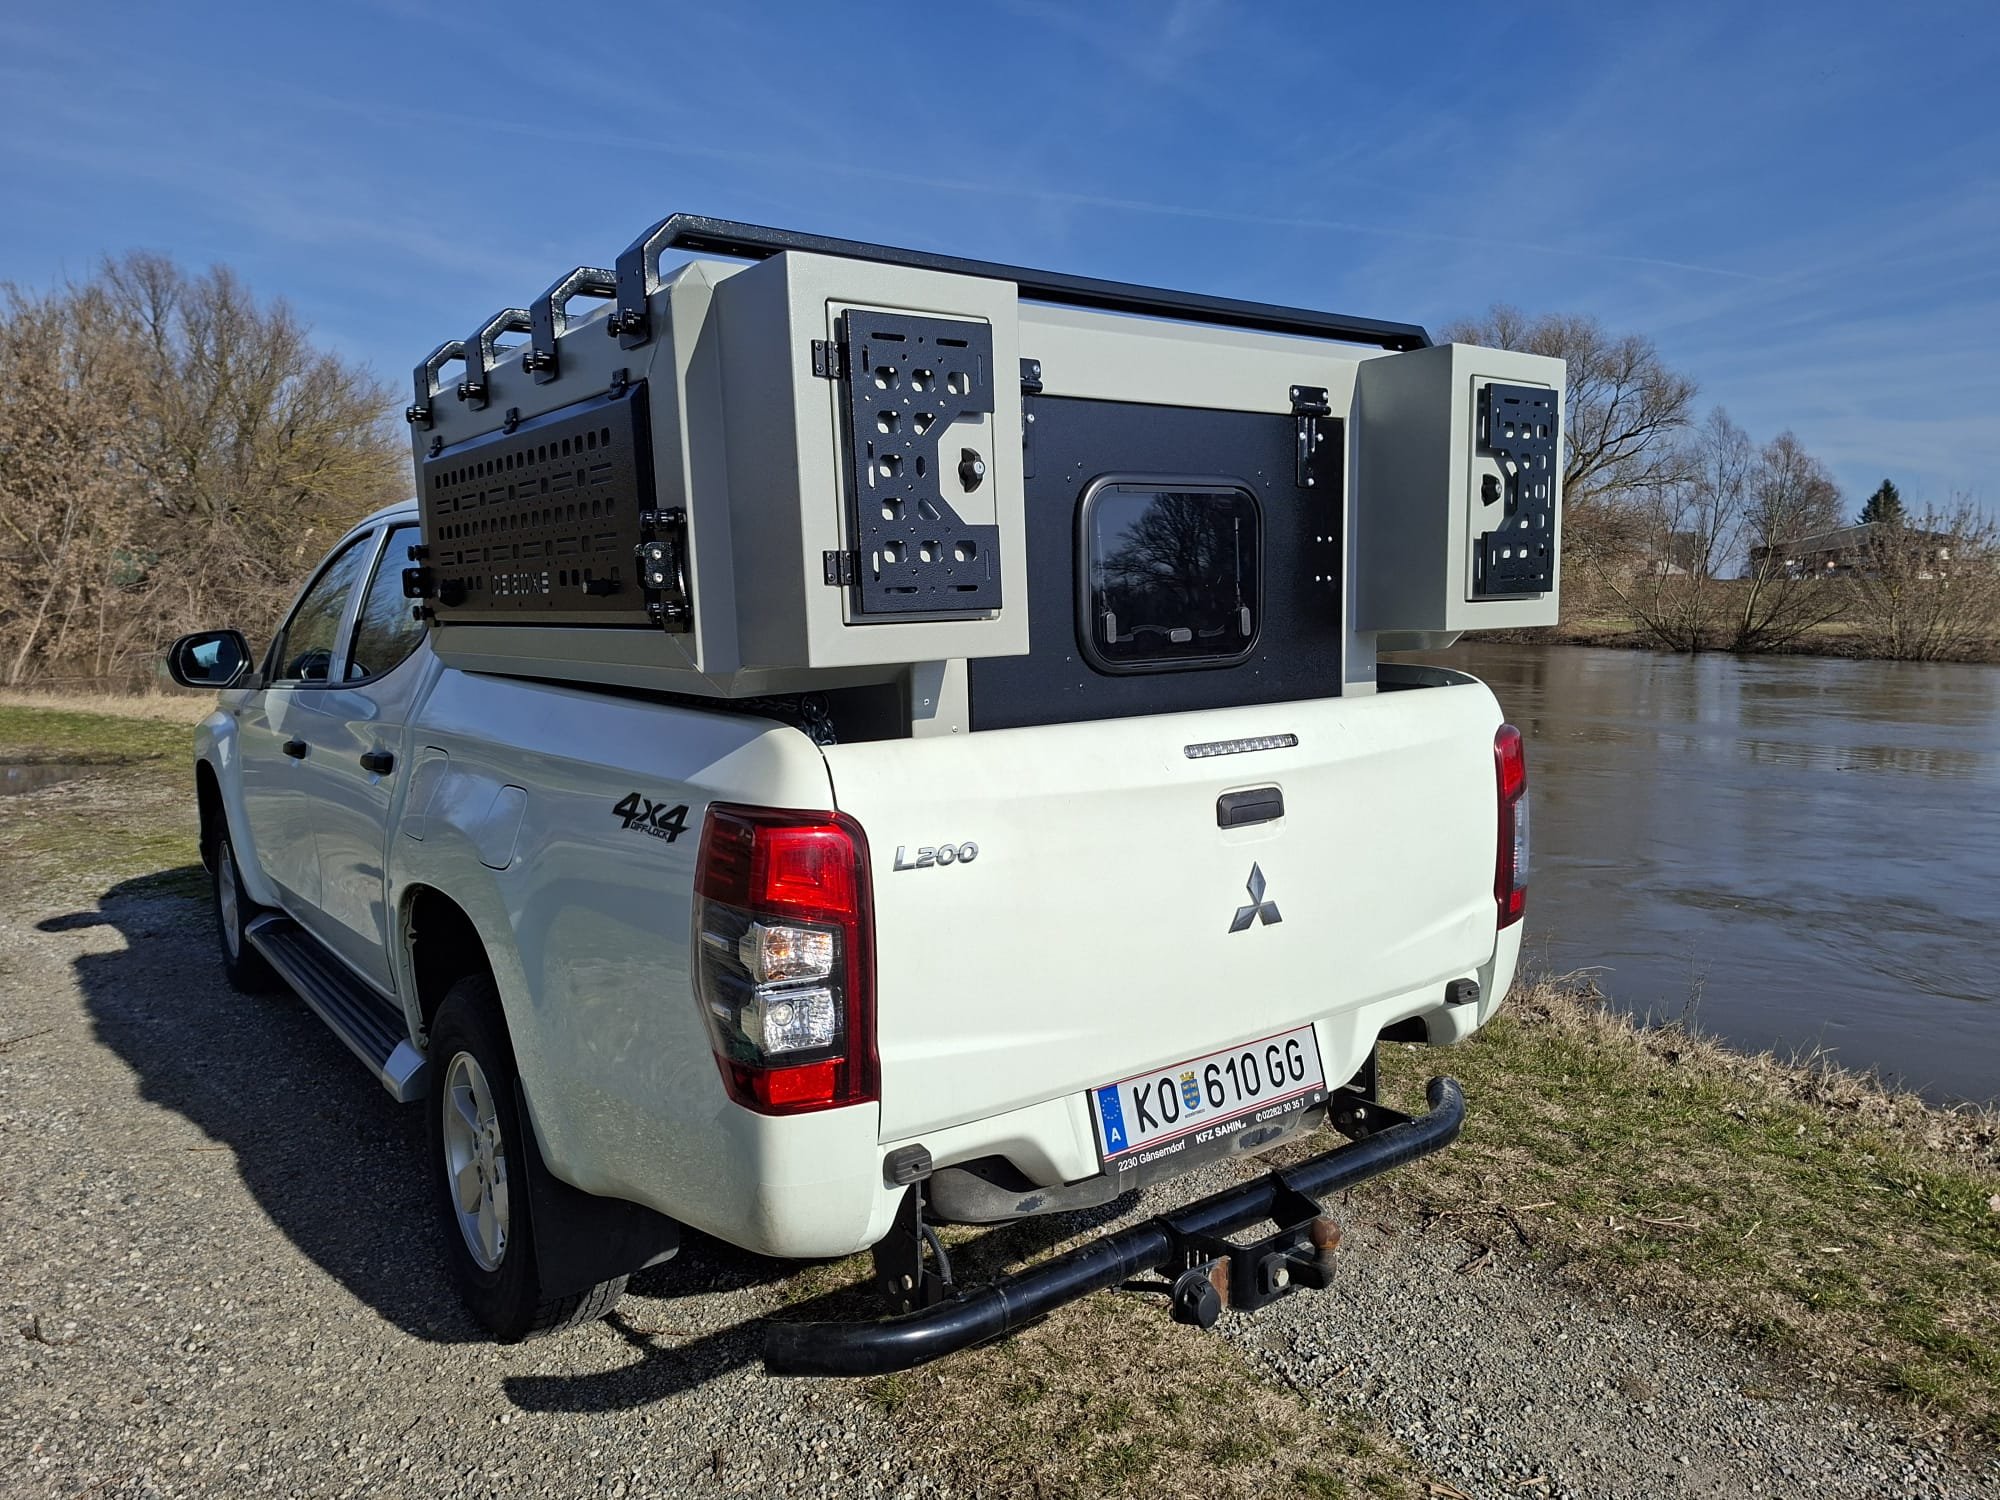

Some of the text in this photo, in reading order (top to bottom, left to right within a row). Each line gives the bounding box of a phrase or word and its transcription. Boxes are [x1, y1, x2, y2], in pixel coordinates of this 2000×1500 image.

[893, 841, 979, 872] L200
[1133, 1038, 1305, 1133] KO 610 GG
[1111, 1127, 1122, 1143] A
[1117, 1156, 1138, 1172] 2230
[1195, 1129, 1215, 1145] KFZ
